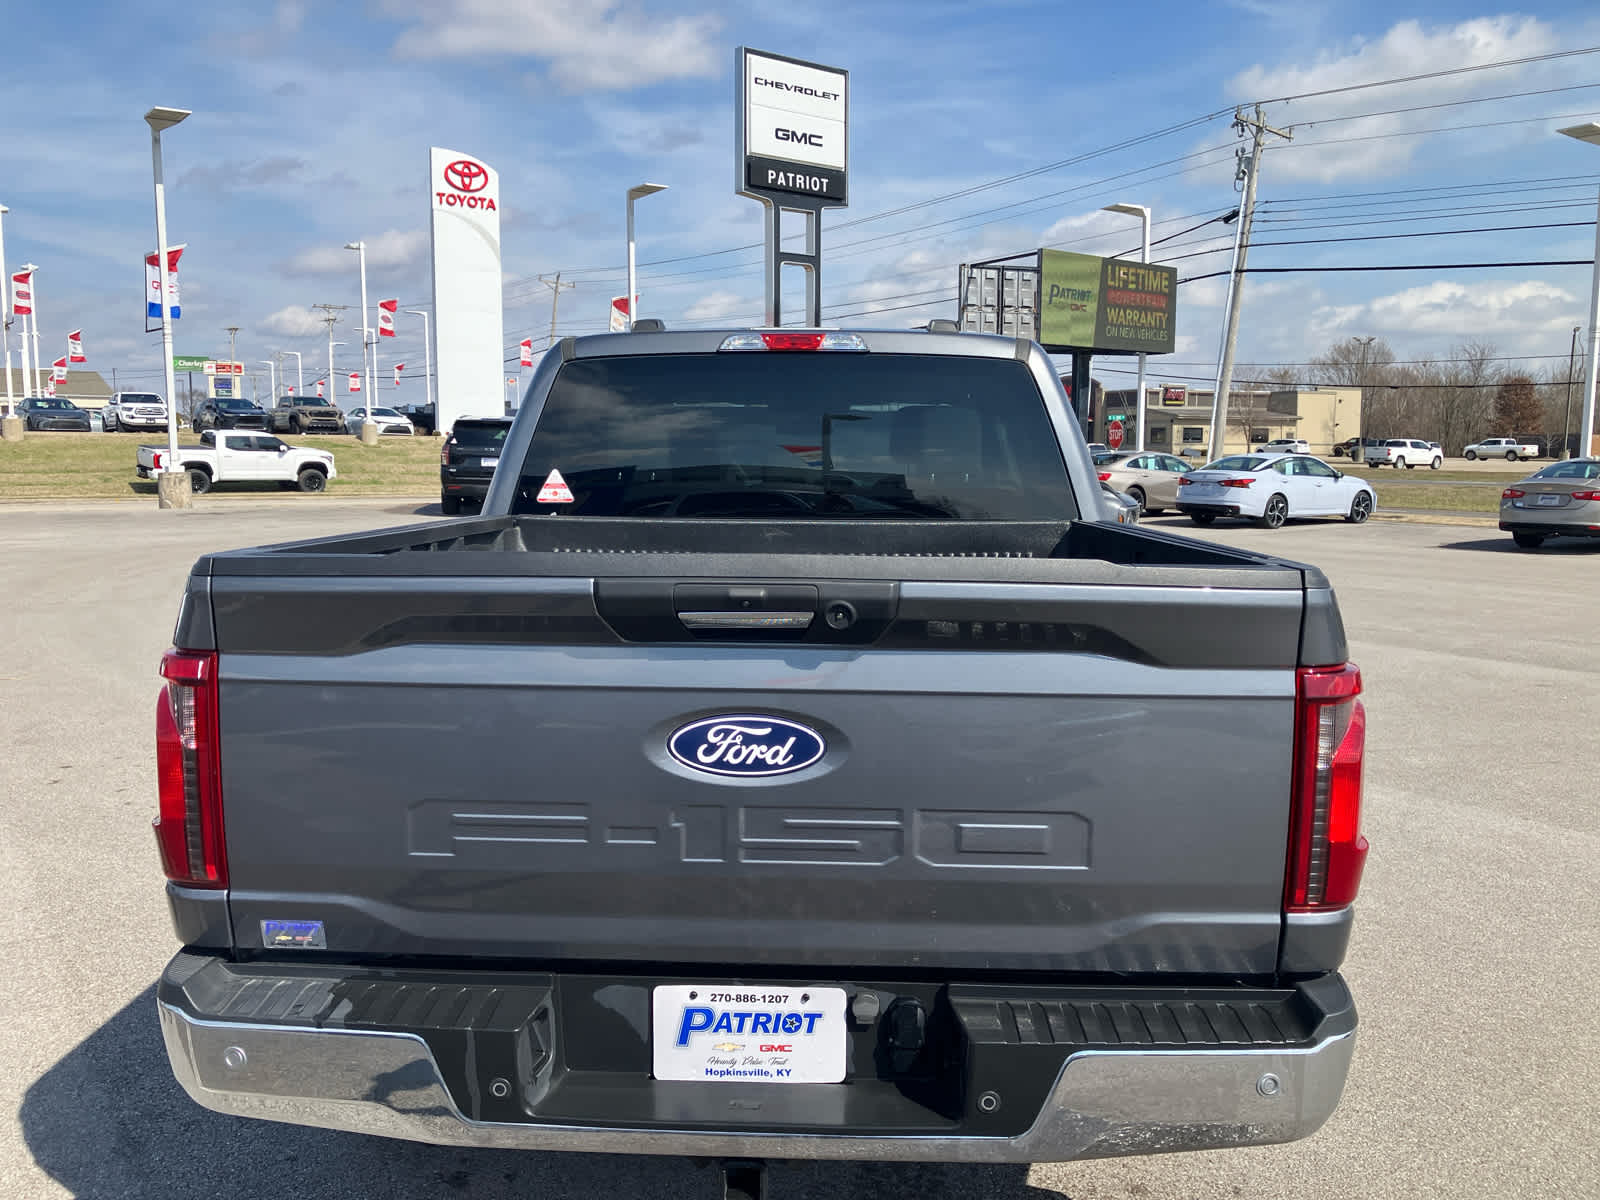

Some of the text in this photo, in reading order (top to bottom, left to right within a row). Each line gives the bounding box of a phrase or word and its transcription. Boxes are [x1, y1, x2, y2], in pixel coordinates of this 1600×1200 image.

[754, 77, 840, 101] CHEVROLET
[775, 127, 823, 147] GMC
[767, 169, 829, 192] PATRIOT
[436, 192, 496, 211] TOYOTA
[1107, 264, 1169, 293] LIFETIME
[1048, 284, 1093, 304] PATRIOT
[1107, 307, 1168, 328] WARRANTY
[1109, 429, 1122, 440] STOP
[697, 725, 794, 766] Ford
[407, 800, 1094, 871] F-150
[710, 993, 789, 1004] 270-886-1207
[674, 1006, 823, 1048] PATRIOT
[759, 1044, 793, 1053] GMC
[705, 1068, 792, 1079] Hopkinsville, KY
